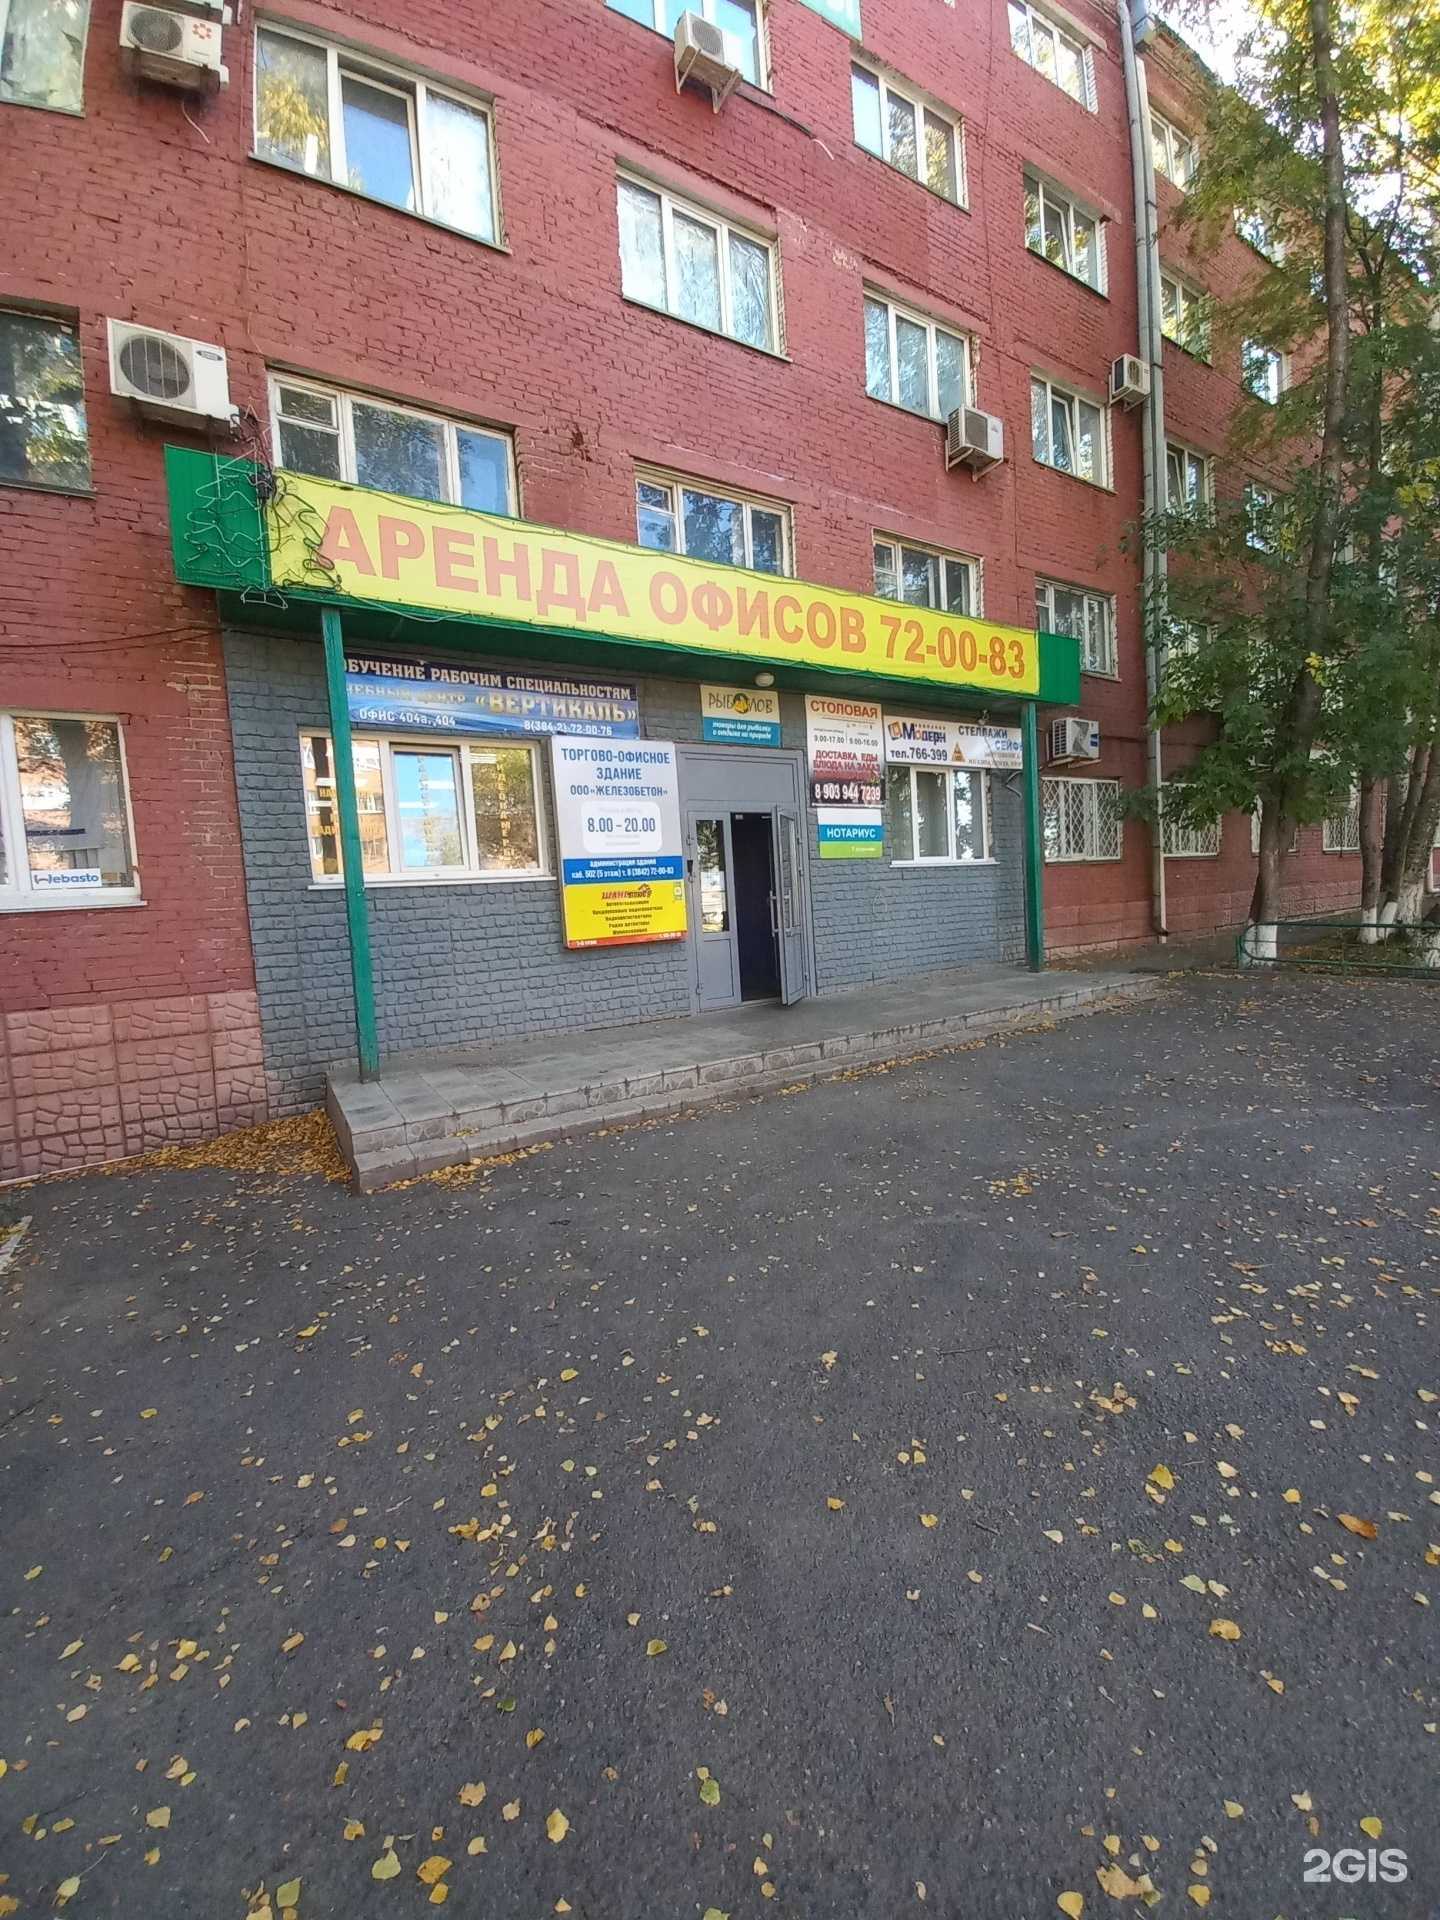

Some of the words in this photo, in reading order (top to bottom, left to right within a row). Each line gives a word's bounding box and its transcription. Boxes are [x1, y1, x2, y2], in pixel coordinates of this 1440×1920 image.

[317, 505, 631, 623] АРЕНДА
[649, 571, 867, 653] ОФИСОВ
[880, 614, 1025, 679] 72-00-83
[431, 667, 502, 688] РАБОЧИМ
[507, 676, 632, 700] СПЕЦИАЛЬНОСТЯМ
[475, 691, 636, 722] «ВЕРТИКАЛЬ»
[810, 700, 878, 719] СТОЛОВАЯ
[359, 708, 395, 721] ОФИС
[958, 725, 1008, 739] СТЕЛЛАЖИ
[561, 748, 670, 764] ТОРГОВО-ОФИСНОЕ
[815, 750, 857, 760] ДОСТАВКА
[861, 753, 878, 762] ЕДЫ
[813, 760, 843, 771] БЛЮДА
[844, 761, 856, 770] НА
[596, 767, 642, 781] ЗДАНИЕ
[570, 784, 589, 795] ООО
[590, 785, 668, 797] «ЖЕЛЕЗОБЕТОН»
[815, 783, 821, 799] 8
[823, 784, 840, 800] 903
[842, 785, 859, 800] 944
[860, 786, 881, 801] 7239
[587, 817, 614, 832] 8.00
[624, 817, 656, 832] 20.00
[826, 827, 876, 838] НОТАРИУС
